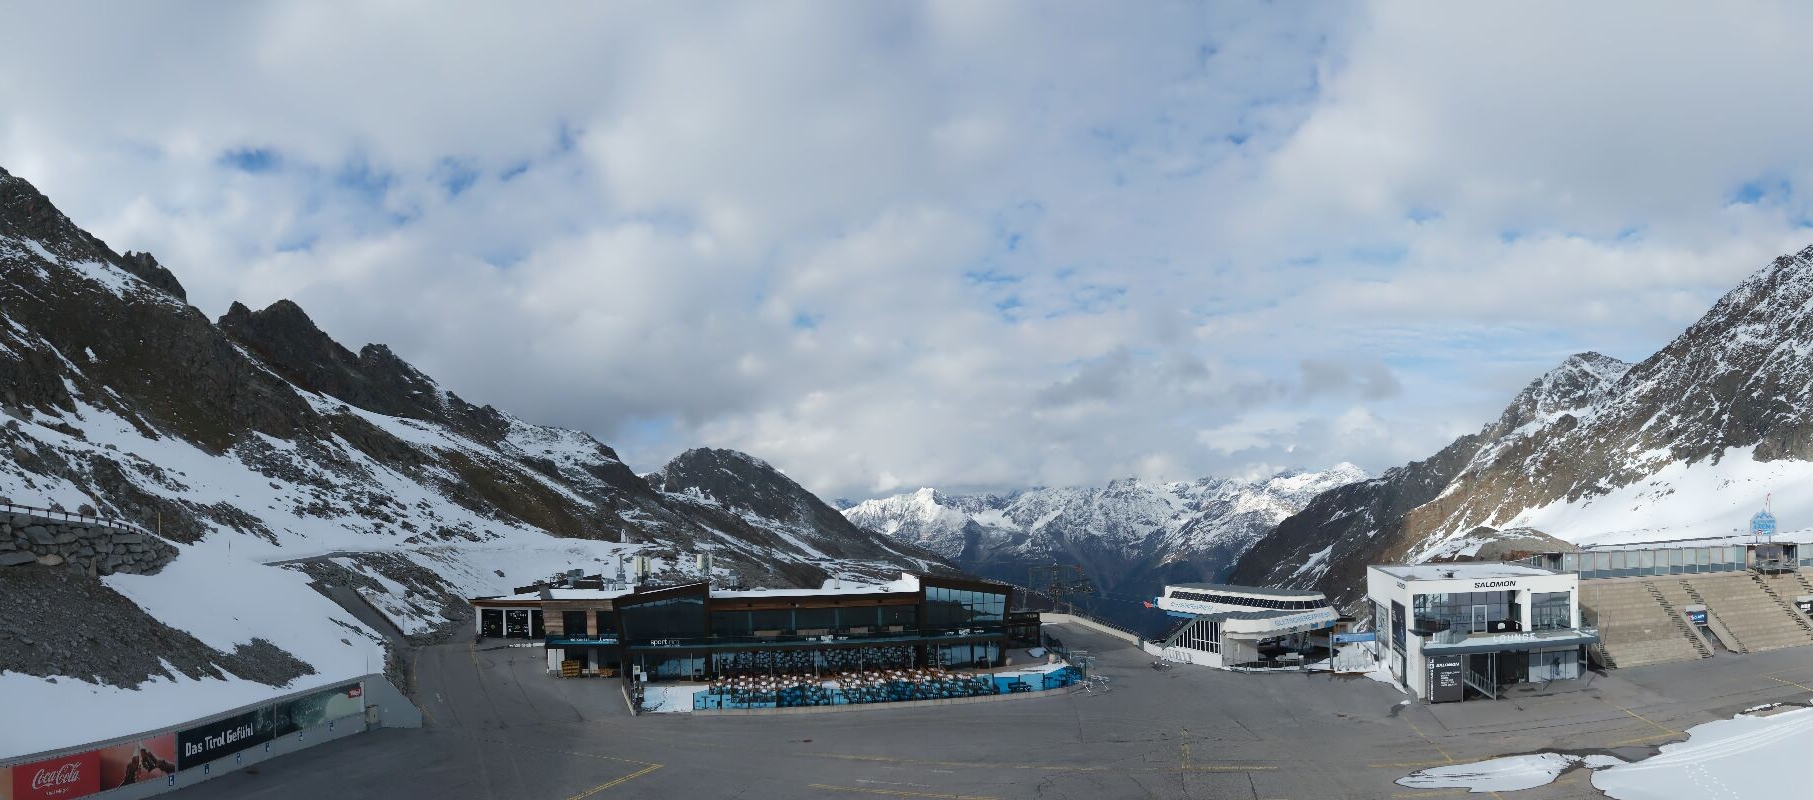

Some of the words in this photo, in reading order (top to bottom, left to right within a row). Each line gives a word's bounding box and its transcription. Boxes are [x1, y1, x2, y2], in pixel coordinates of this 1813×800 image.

[1474, 580, 1516, 588] SALOMON
[1493, 632, 1537, 642] LOUNGE
[650, 638, 668, 647] sport
[185, 742, 203, 758] Das
[204, 731, 225, 751] Tirol
[226, 722, 254, 744] Gefühl
[31, 762, 82, 789] Coca-Cola
